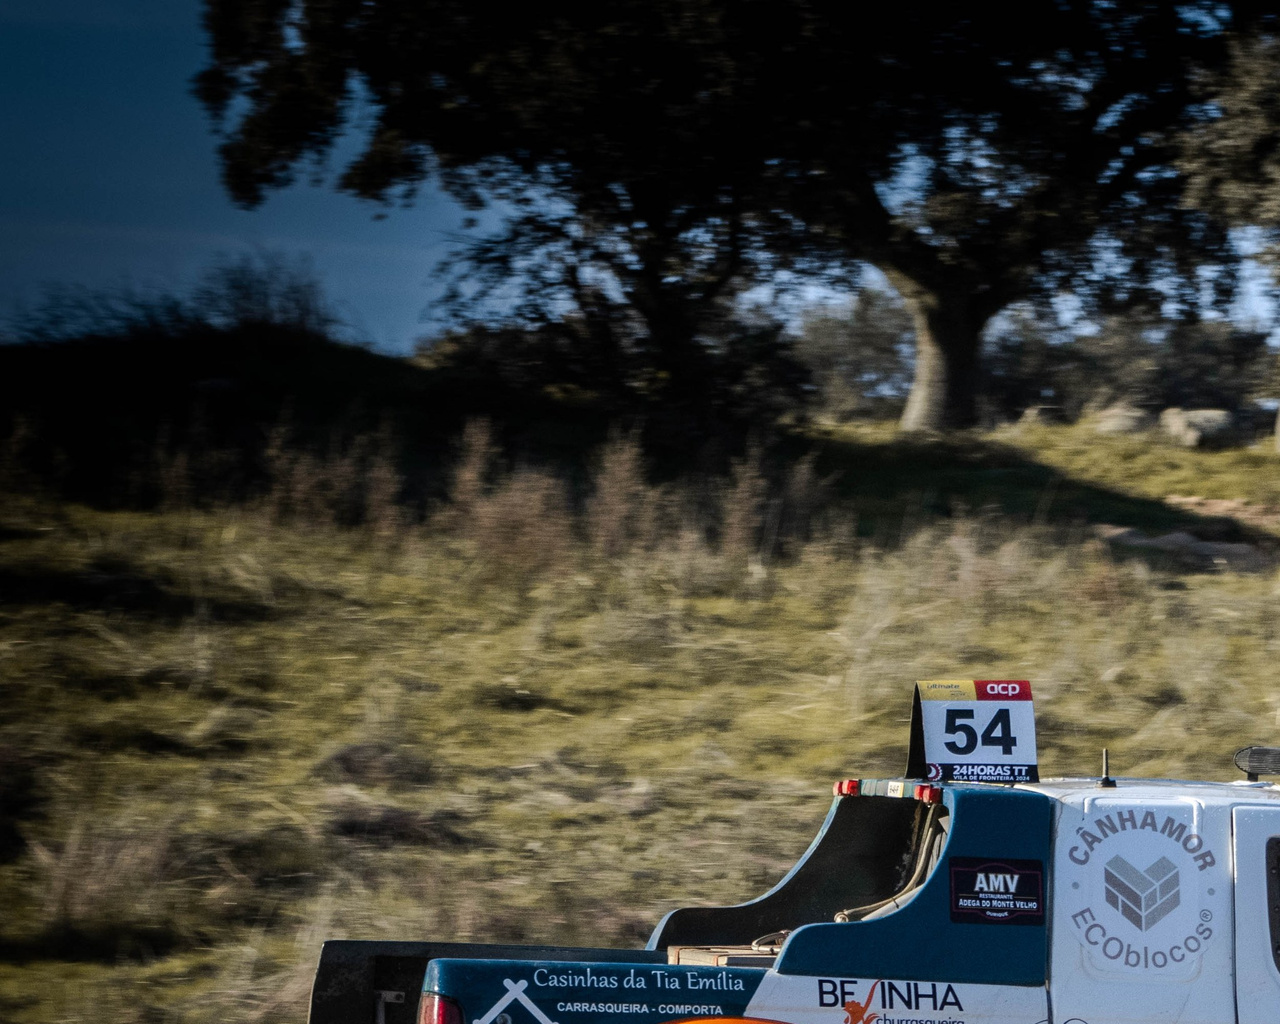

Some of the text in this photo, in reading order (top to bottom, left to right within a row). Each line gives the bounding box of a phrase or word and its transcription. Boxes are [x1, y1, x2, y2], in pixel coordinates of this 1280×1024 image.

[986, 683, 1020, 697] acp
[943, 708, 1018, 756] 54
[952, 765, 1029, 777] 24HORAS TT
[1068, 809, 1217, 872] CÂNHAMOR
[974, 872, 1020, 893] AMV
[959, 899, 980, 907] ADEGA
[991, 900, 1014, 908] MONTE
[1015, 901, 1037, 909] VELHO
[533, 967, 745, 991] Casinhas da Tia Emília
[557, 1002, 649, 1014] CARRASQUEIRA
[658, 1004, 724, 1015] COMPORTA
